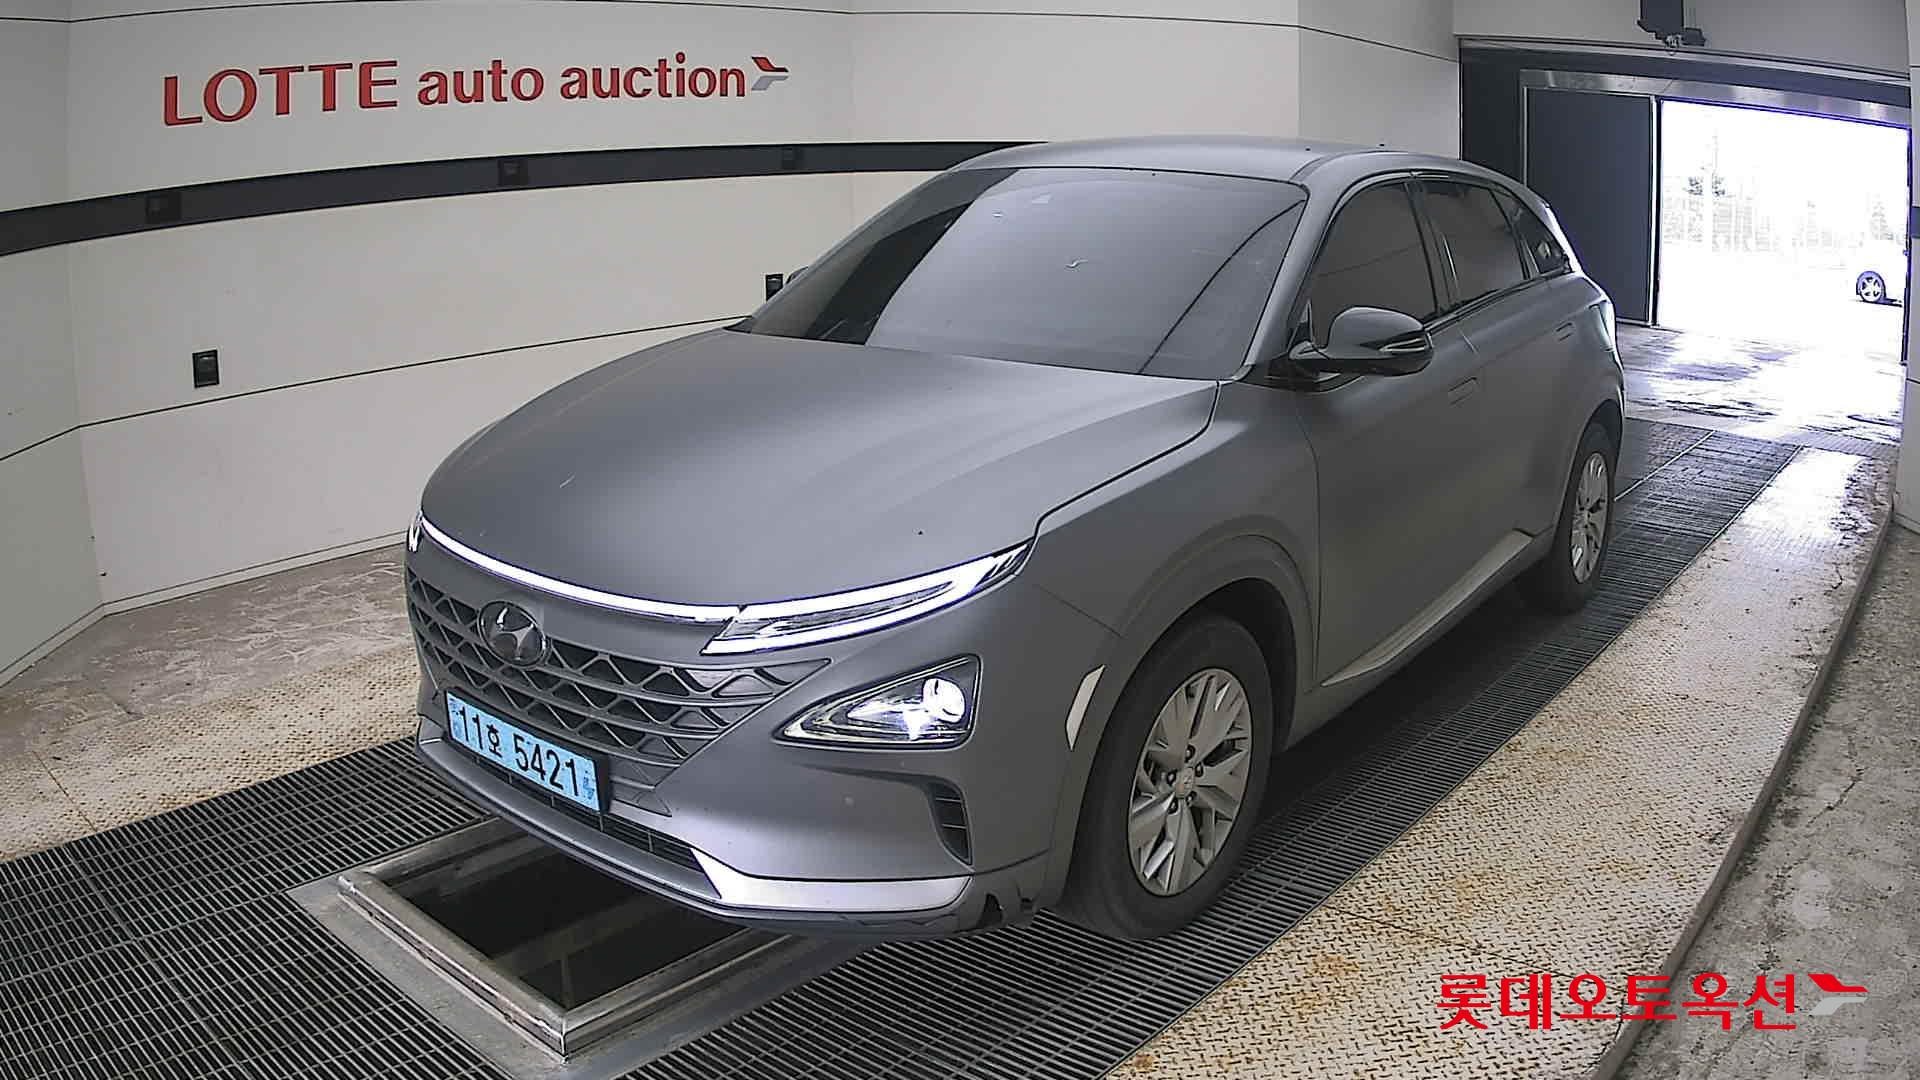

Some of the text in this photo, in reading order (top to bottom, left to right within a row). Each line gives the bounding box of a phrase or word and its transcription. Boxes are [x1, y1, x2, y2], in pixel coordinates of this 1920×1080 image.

[164, 52, 747, 126] LOTTE auto auction
[459, 706, 579, 797] 11호 5421
